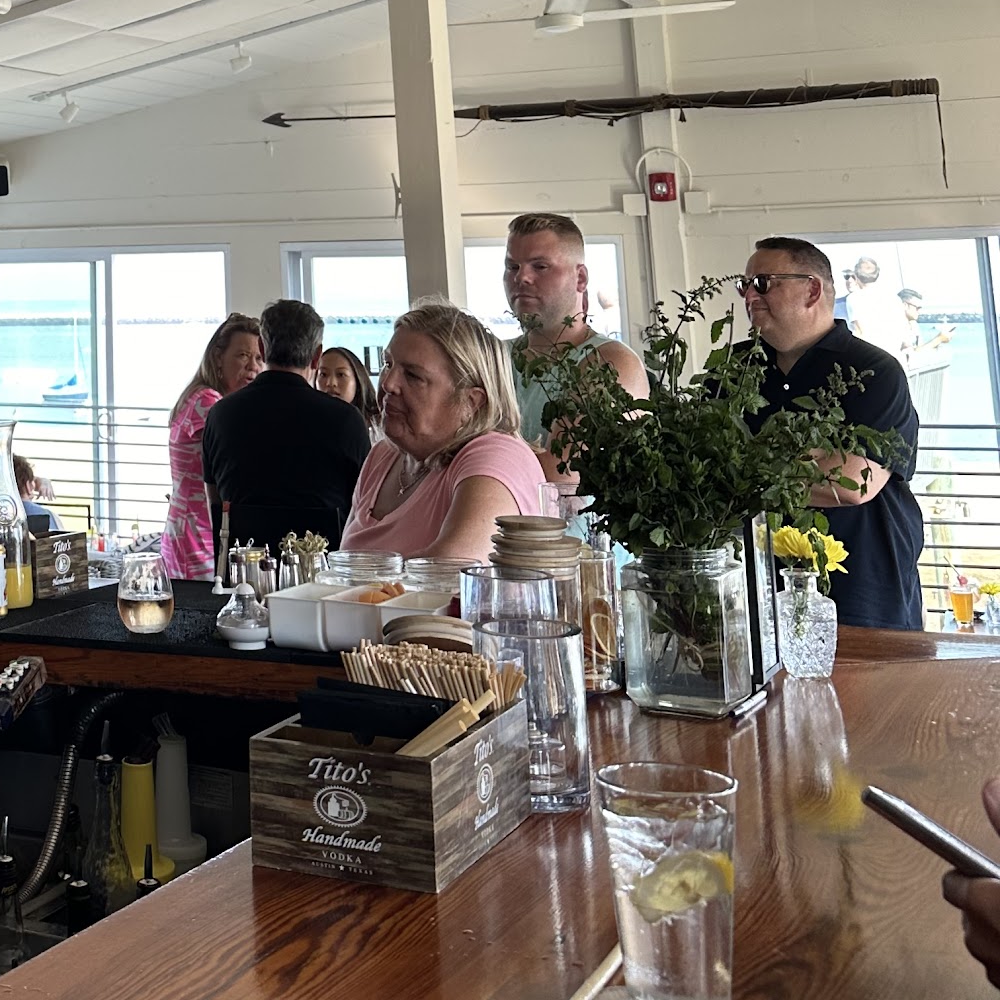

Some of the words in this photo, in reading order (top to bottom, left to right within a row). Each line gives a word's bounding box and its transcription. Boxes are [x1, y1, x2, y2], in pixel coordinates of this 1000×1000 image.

[53, 539, 72, 554] Tito's
[473, 734, 494, 767] Tito's
[307, 756, 371, 785] Tito's
[301, 826, 382, 853] Handmade
[321, 850, 363, 864] VODKA
[311, 861, 336, 870] AUSTIN
[348, 866, 374, 876] TEXAS
